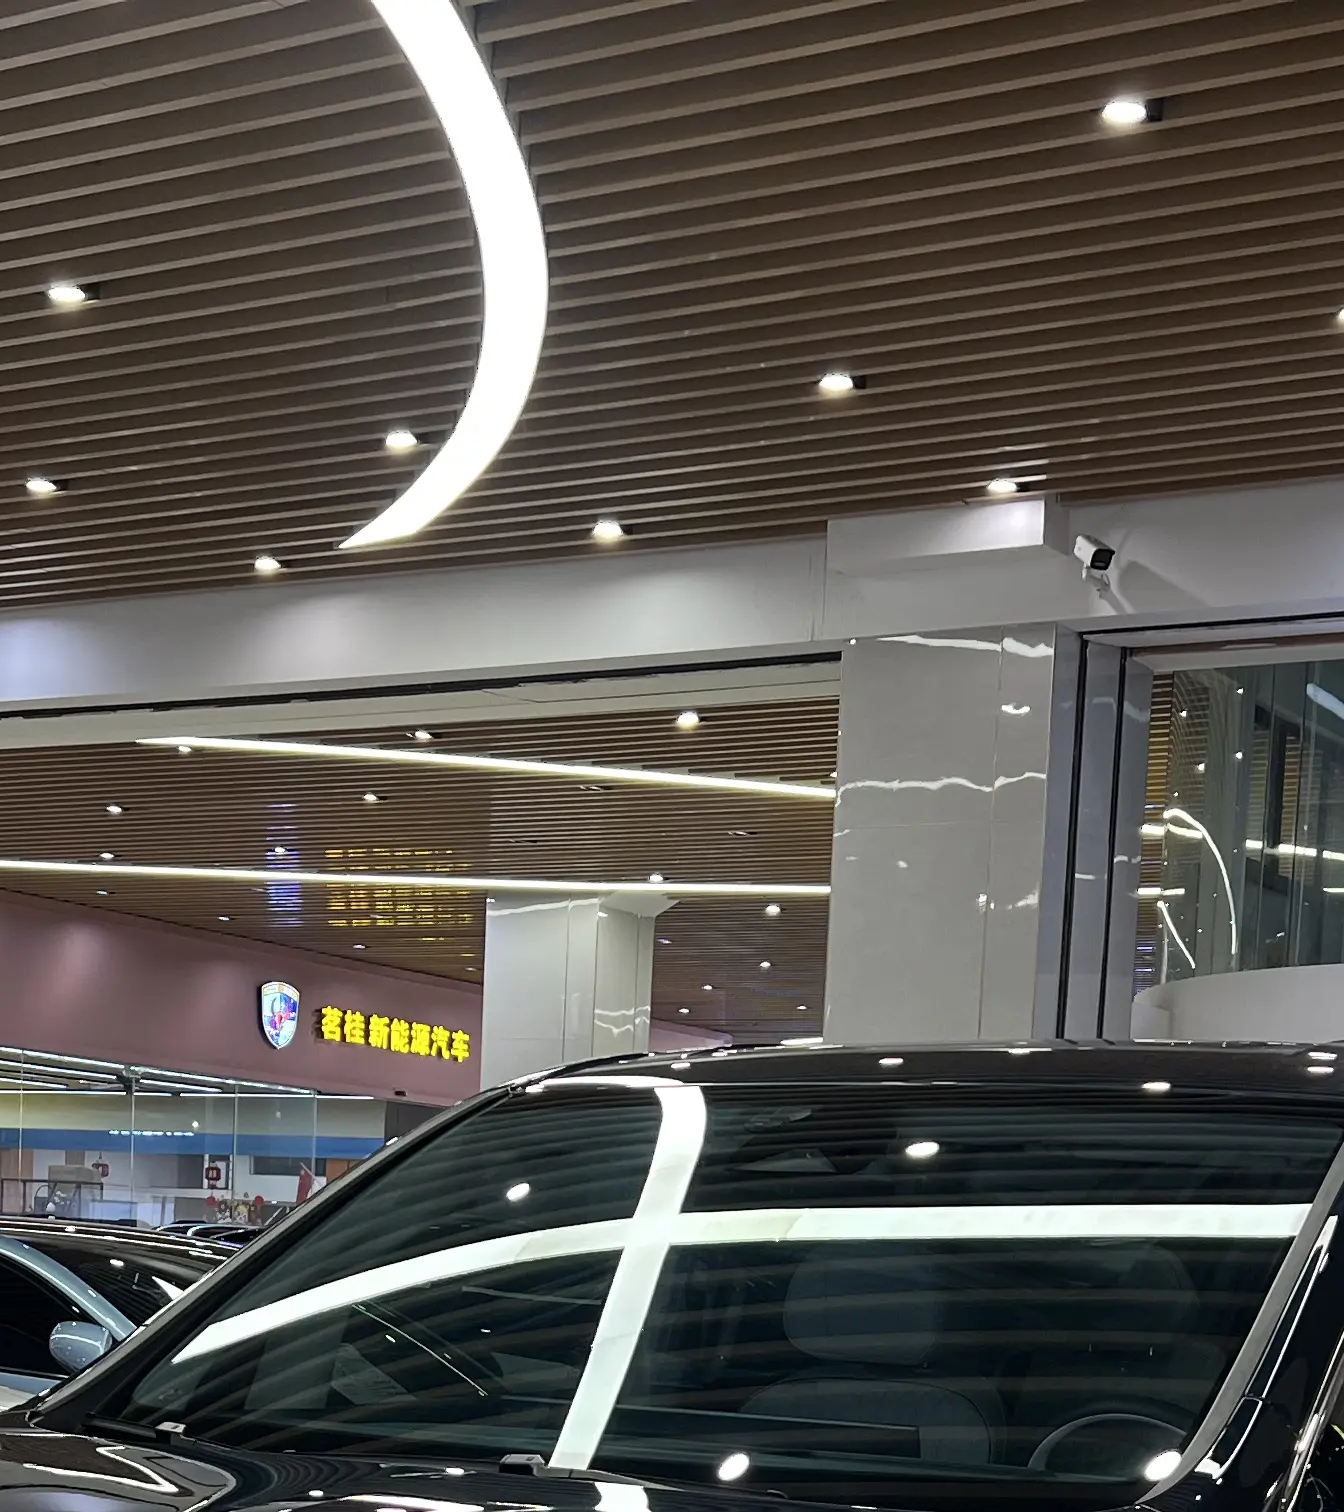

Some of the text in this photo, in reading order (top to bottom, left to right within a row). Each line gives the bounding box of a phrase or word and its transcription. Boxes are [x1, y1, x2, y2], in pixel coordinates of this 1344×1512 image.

[320, 1005, 470, 1062] 茗桂新能源汽车
